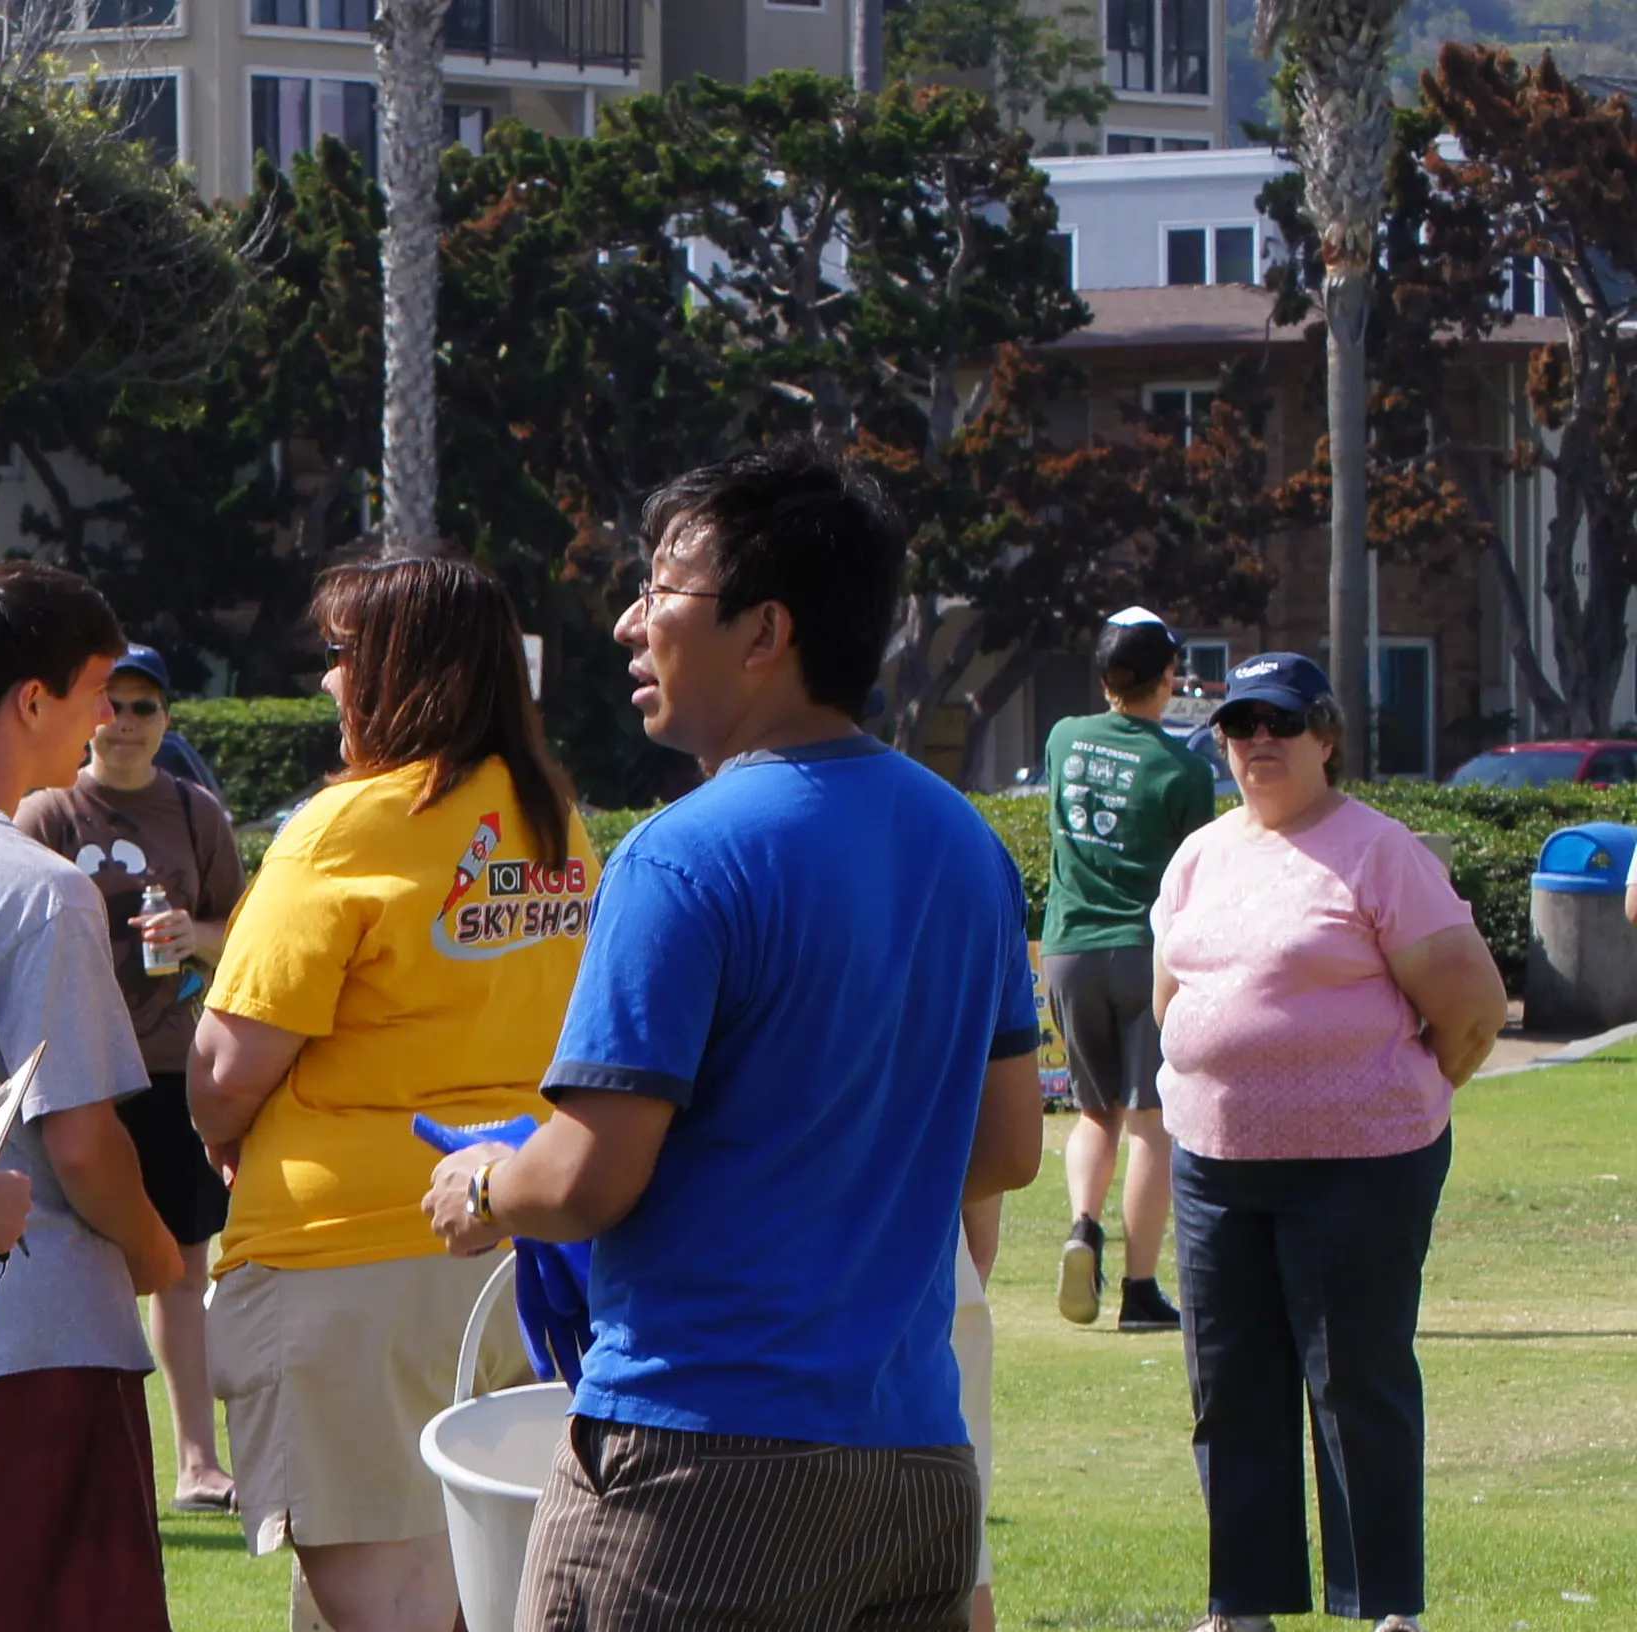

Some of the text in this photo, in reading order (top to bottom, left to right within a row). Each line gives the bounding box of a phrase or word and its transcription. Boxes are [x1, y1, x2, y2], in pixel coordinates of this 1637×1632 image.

[492, 859, 586, 894] 101 KGB
[455, 900, 521, 944] SKY
